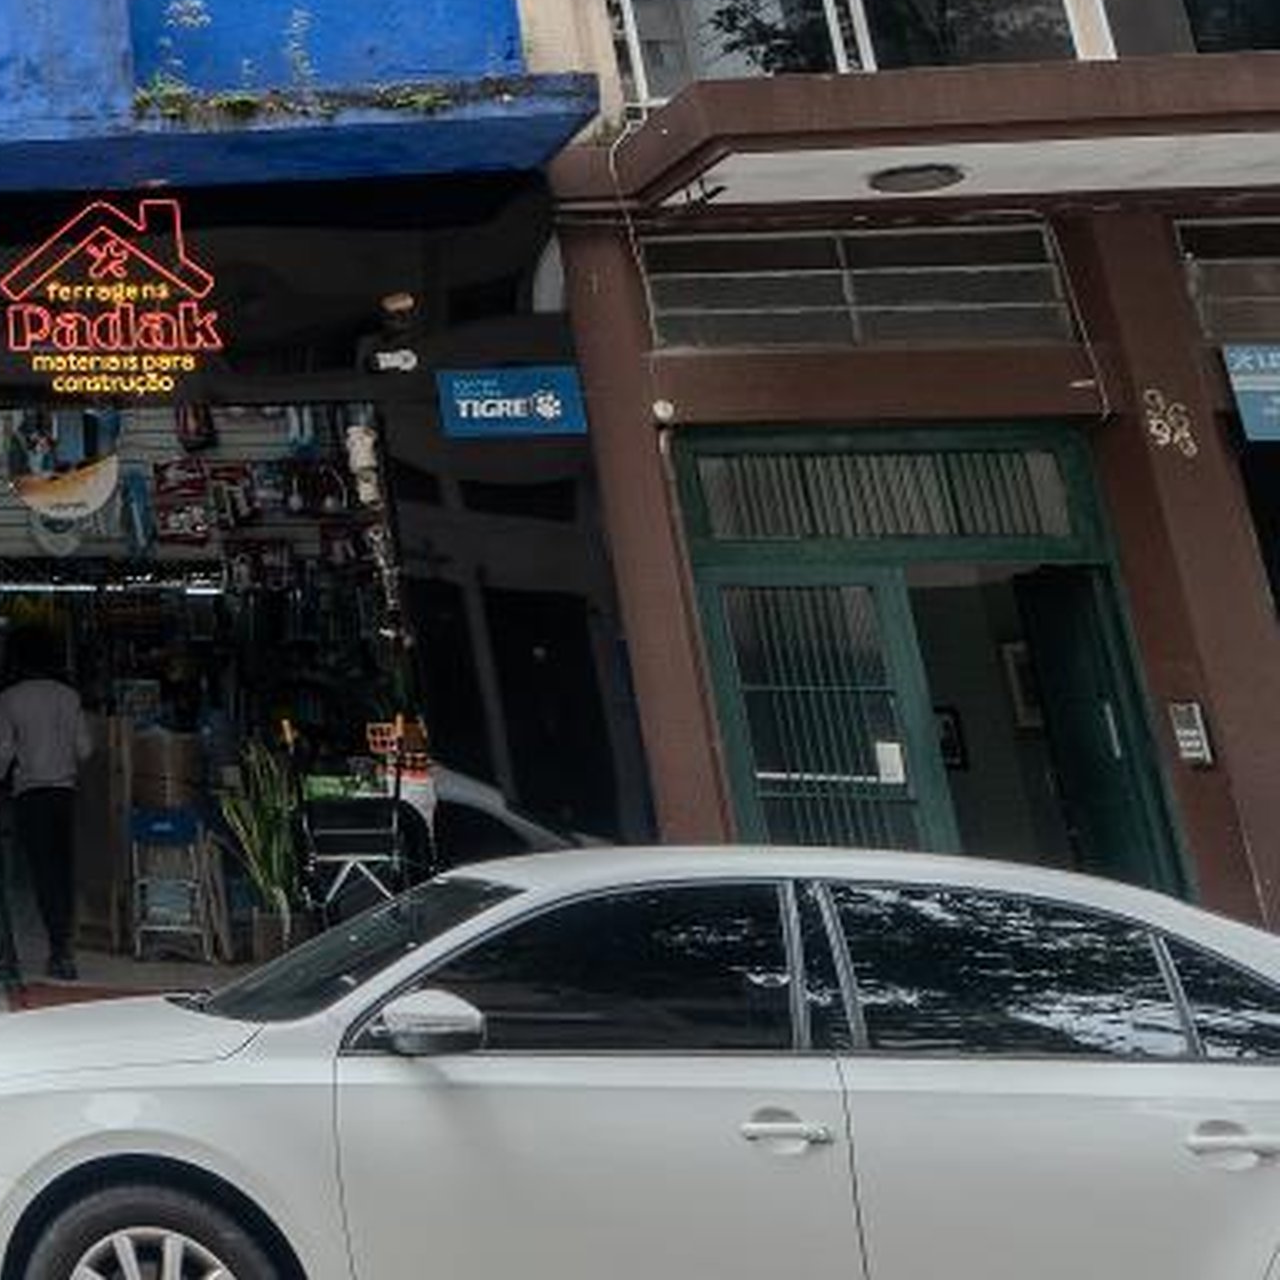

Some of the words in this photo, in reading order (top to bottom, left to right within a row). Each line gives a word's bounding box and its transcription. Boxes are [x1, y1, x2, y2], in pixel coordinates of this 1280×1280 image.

[47, 281, 170, 302] ferragens
[7, 302, 222, 351] Padak
[32, 353, 138, 371] materiais
[142, 354, 196, 375] para
[52, 374, 174, 394] construção
[456, 398, 528, 419] TIGRE
